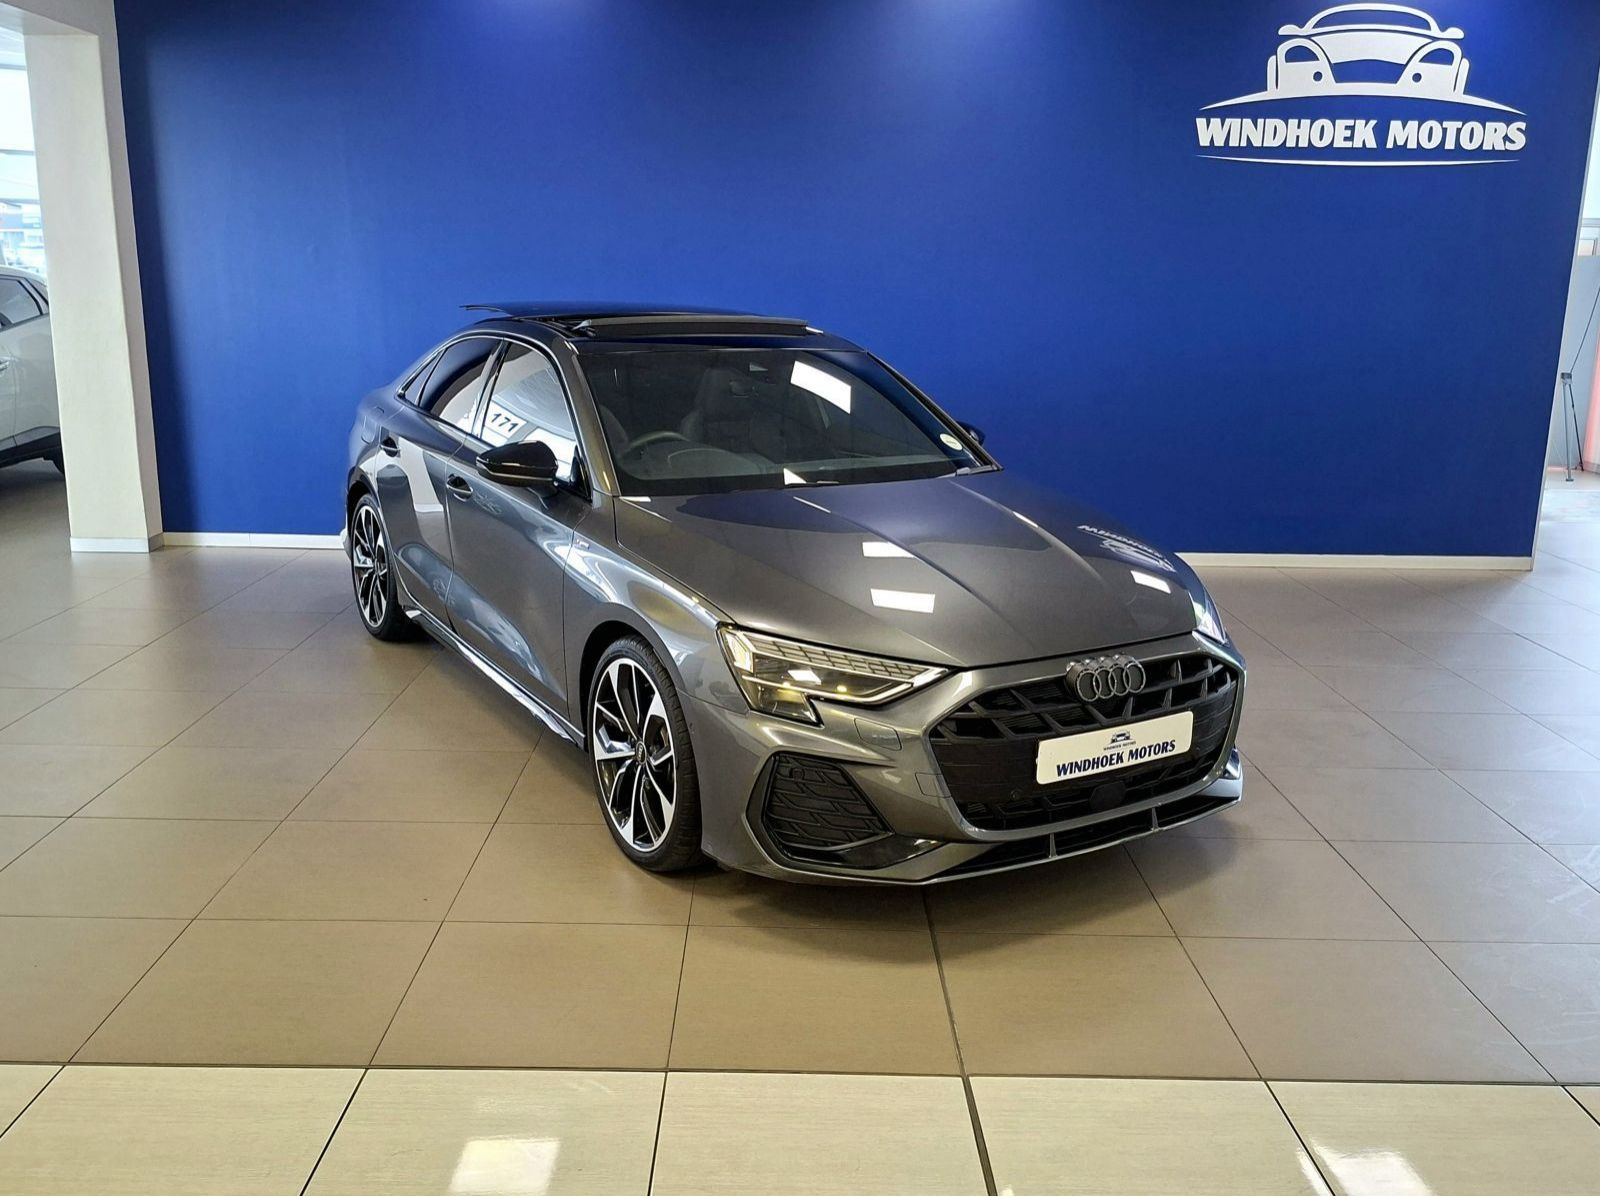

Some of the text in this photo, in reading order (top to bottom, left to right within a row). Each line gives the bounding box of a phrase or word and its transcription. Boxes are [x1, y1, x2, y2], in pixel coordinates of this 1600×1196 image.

[1195, 117, 1527, 151] WINDHOEK MOTORS
[491, 412, 519, 433] 171
[1056, 739, 1176, 777] WINDHOEK MOTORS
